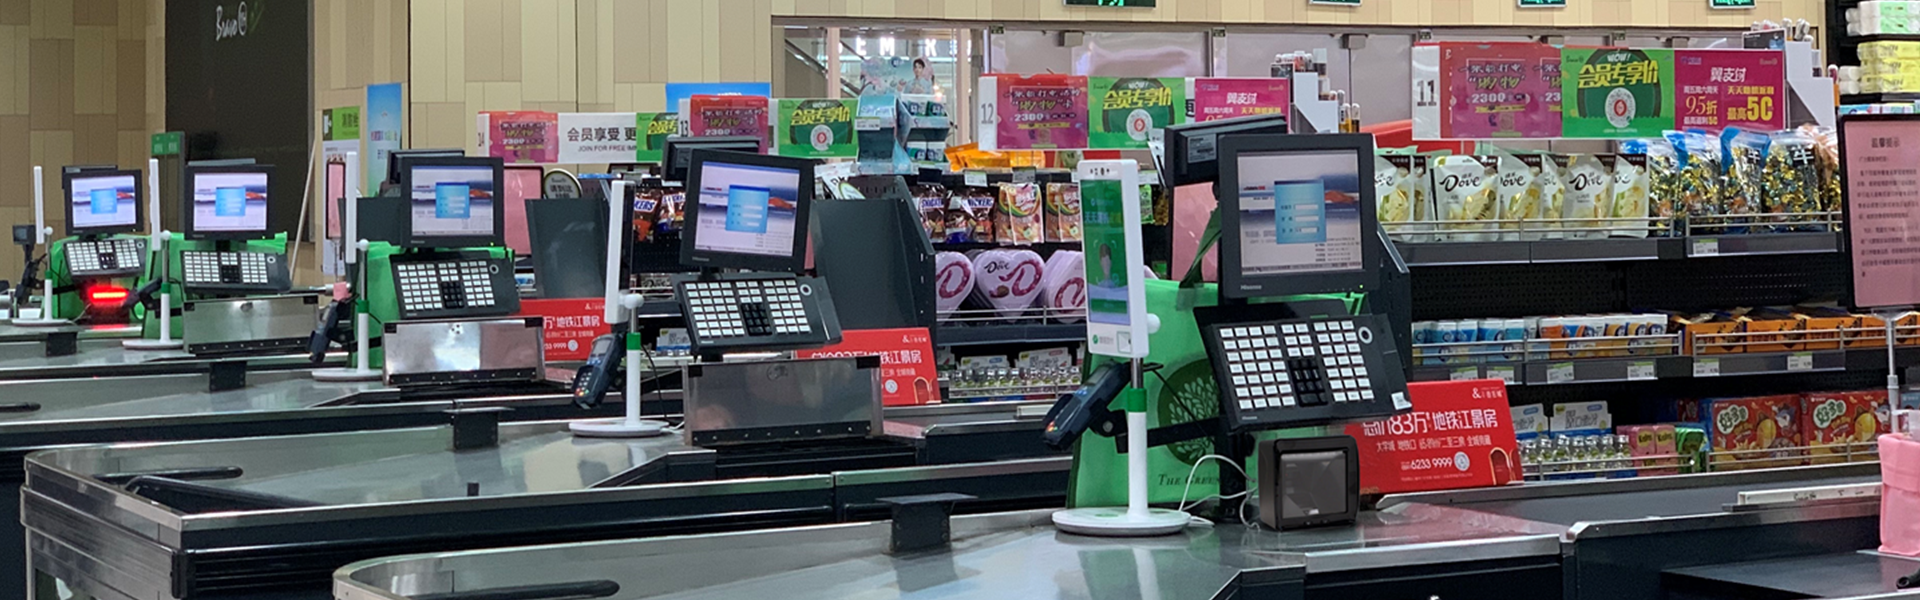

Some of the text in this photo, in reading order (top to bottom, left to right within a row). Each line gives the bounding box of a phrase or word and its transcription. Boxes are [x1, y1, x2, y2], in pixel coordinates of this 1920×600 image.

[1577, 60, 1659, 89] 会员专享价
[1710, 67, 1747, 82] 翼支付
[1103, 87, 1173, 110] 会员专享价
[1226, 92, 1258, 106] 翼支付
[1417, 79, 1437, 107] 11
[1471, 92, 1506, 103] 2300
[1685, 95, 1718, 115] 95折
[791, 106, 850, 126] 会员专享价
[981, 102, 994, 125] 12
[1014, 113, 1044, 122] 2300
[567, 127, 620, 142] 会员享受
[578, 145, 593, 153] JOIN
[1871, 137, 1900, 148] 温馨提示
[1793, 145, 1814, 165] 牛
[1439, 174, 1482, 192] Dove
[1500, 175, 1526, 188] ove
[984, 261, 1010, 274] Dove
[1410, 458, 1432, 470] 6233
[1433, 456, 1453, 468] 9999
